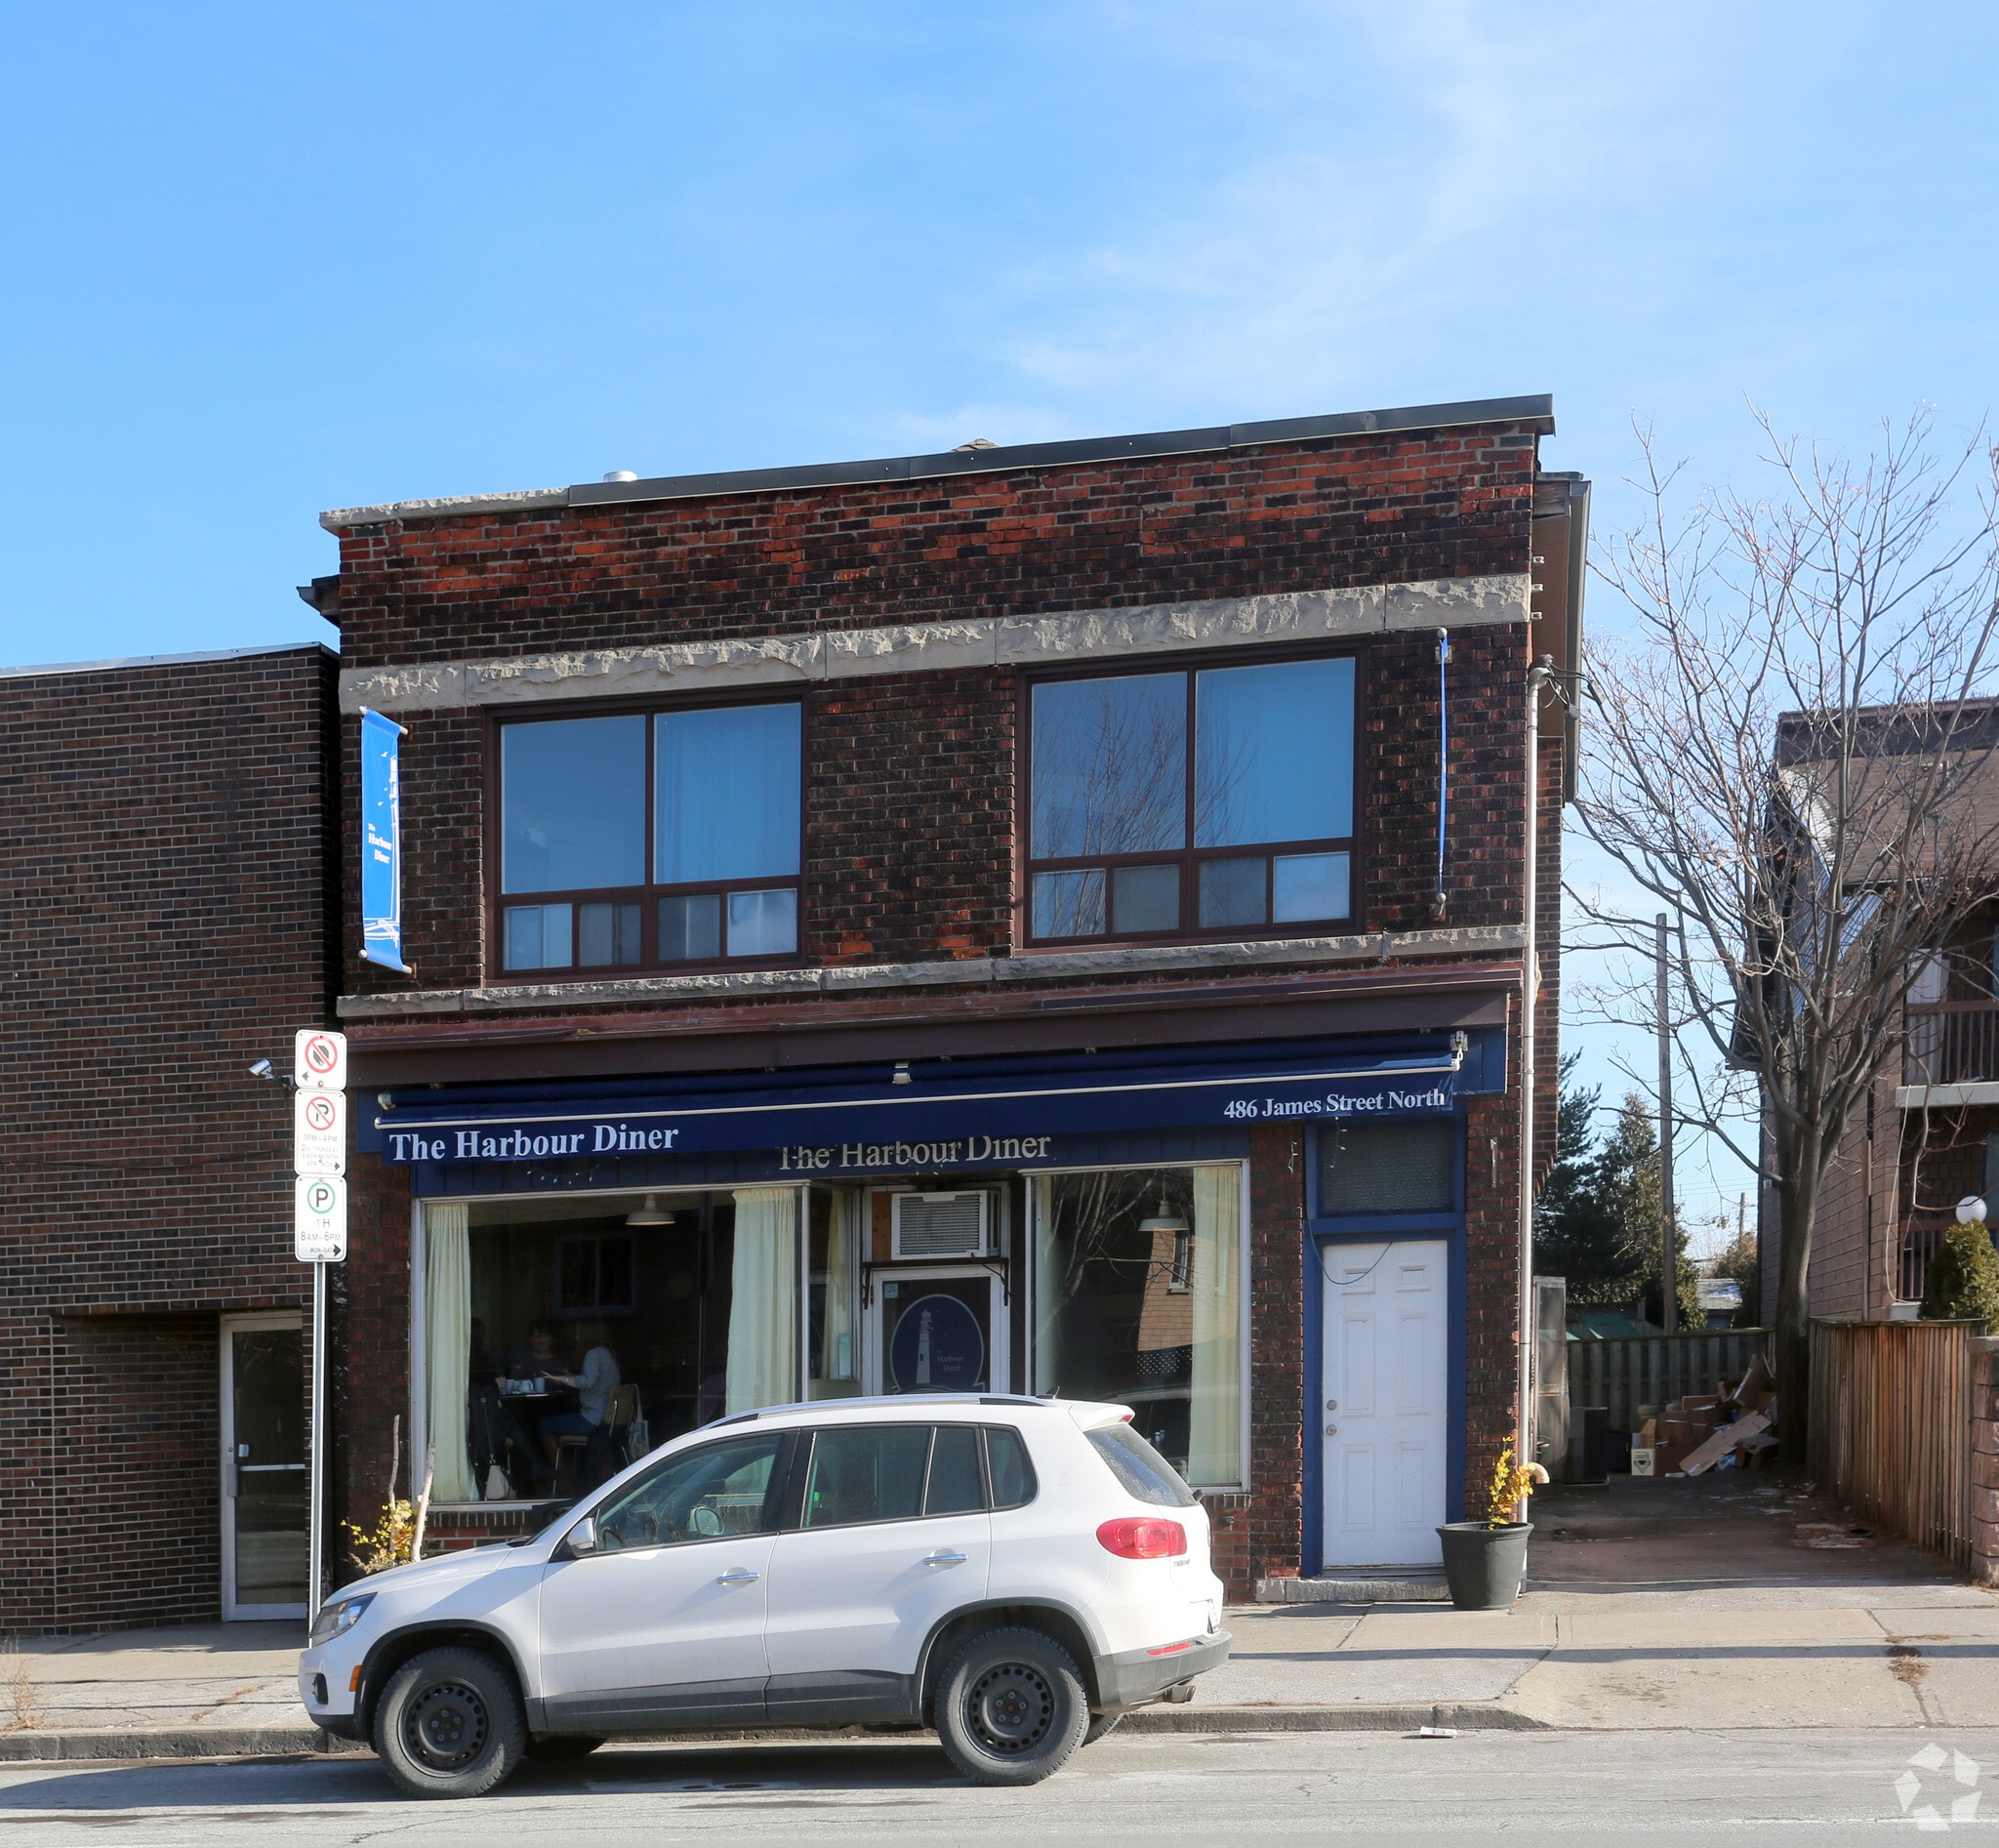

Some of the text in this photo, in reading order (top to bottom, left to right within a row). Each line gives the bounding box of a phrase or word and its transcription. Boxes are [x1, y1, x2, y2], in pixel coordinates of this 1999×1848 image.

[1223, 1088, 1446, 1118] 486 James Street North
[388, 1124, 679, 1161] The Harbour Diner
[838, 1140, 962, 1168] Harbour
[964, 1135, 1052, 1162] Diner
[315, 1188, 329, 1208] P
[323, 1218, 331, 1228] H
